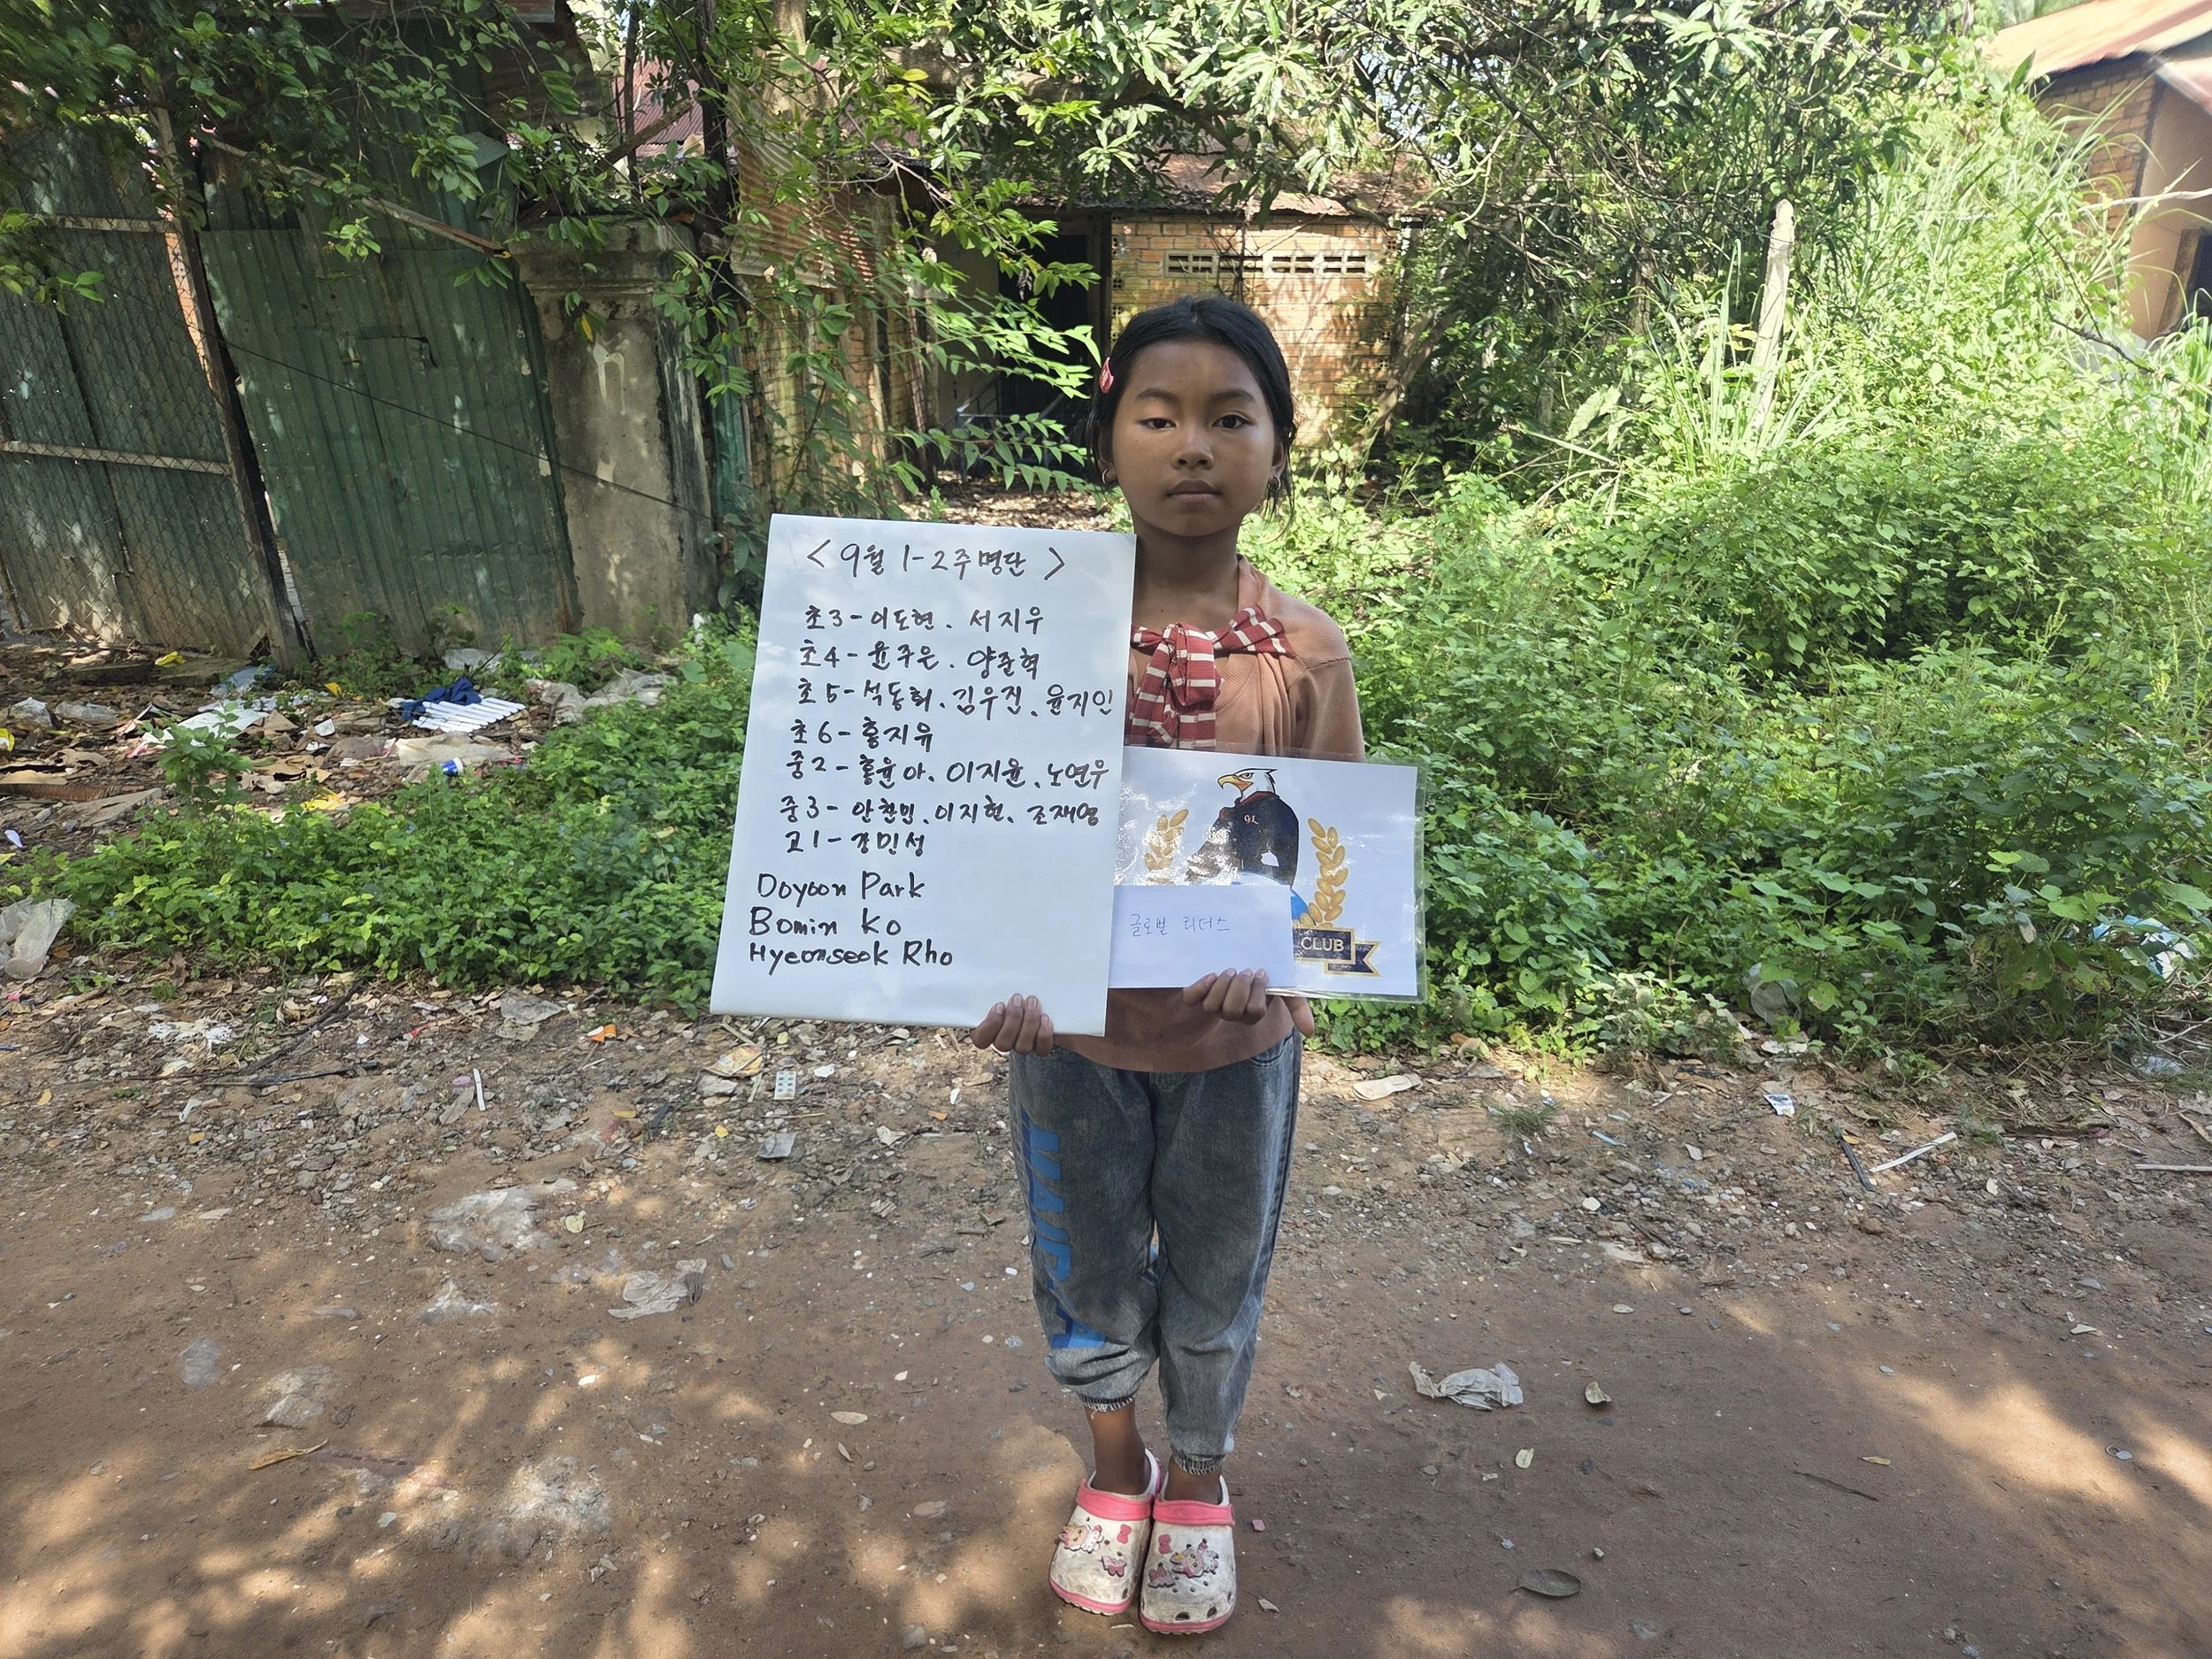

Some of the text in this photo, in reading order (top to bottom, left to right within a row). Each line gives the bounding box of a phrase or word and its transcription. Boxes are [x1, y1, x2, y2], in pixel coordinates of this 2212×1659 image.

[841, 542, 885, 578] 9월
[970, 606, 1044, 634] 서지우
[758, 870, 926, 907] Doyoon Park
[749, 906, 837, 935] Bomin
[749, 939, 953, 975] Hyeonseok Rho
[1300, 936, 1344, 952] CLUB
